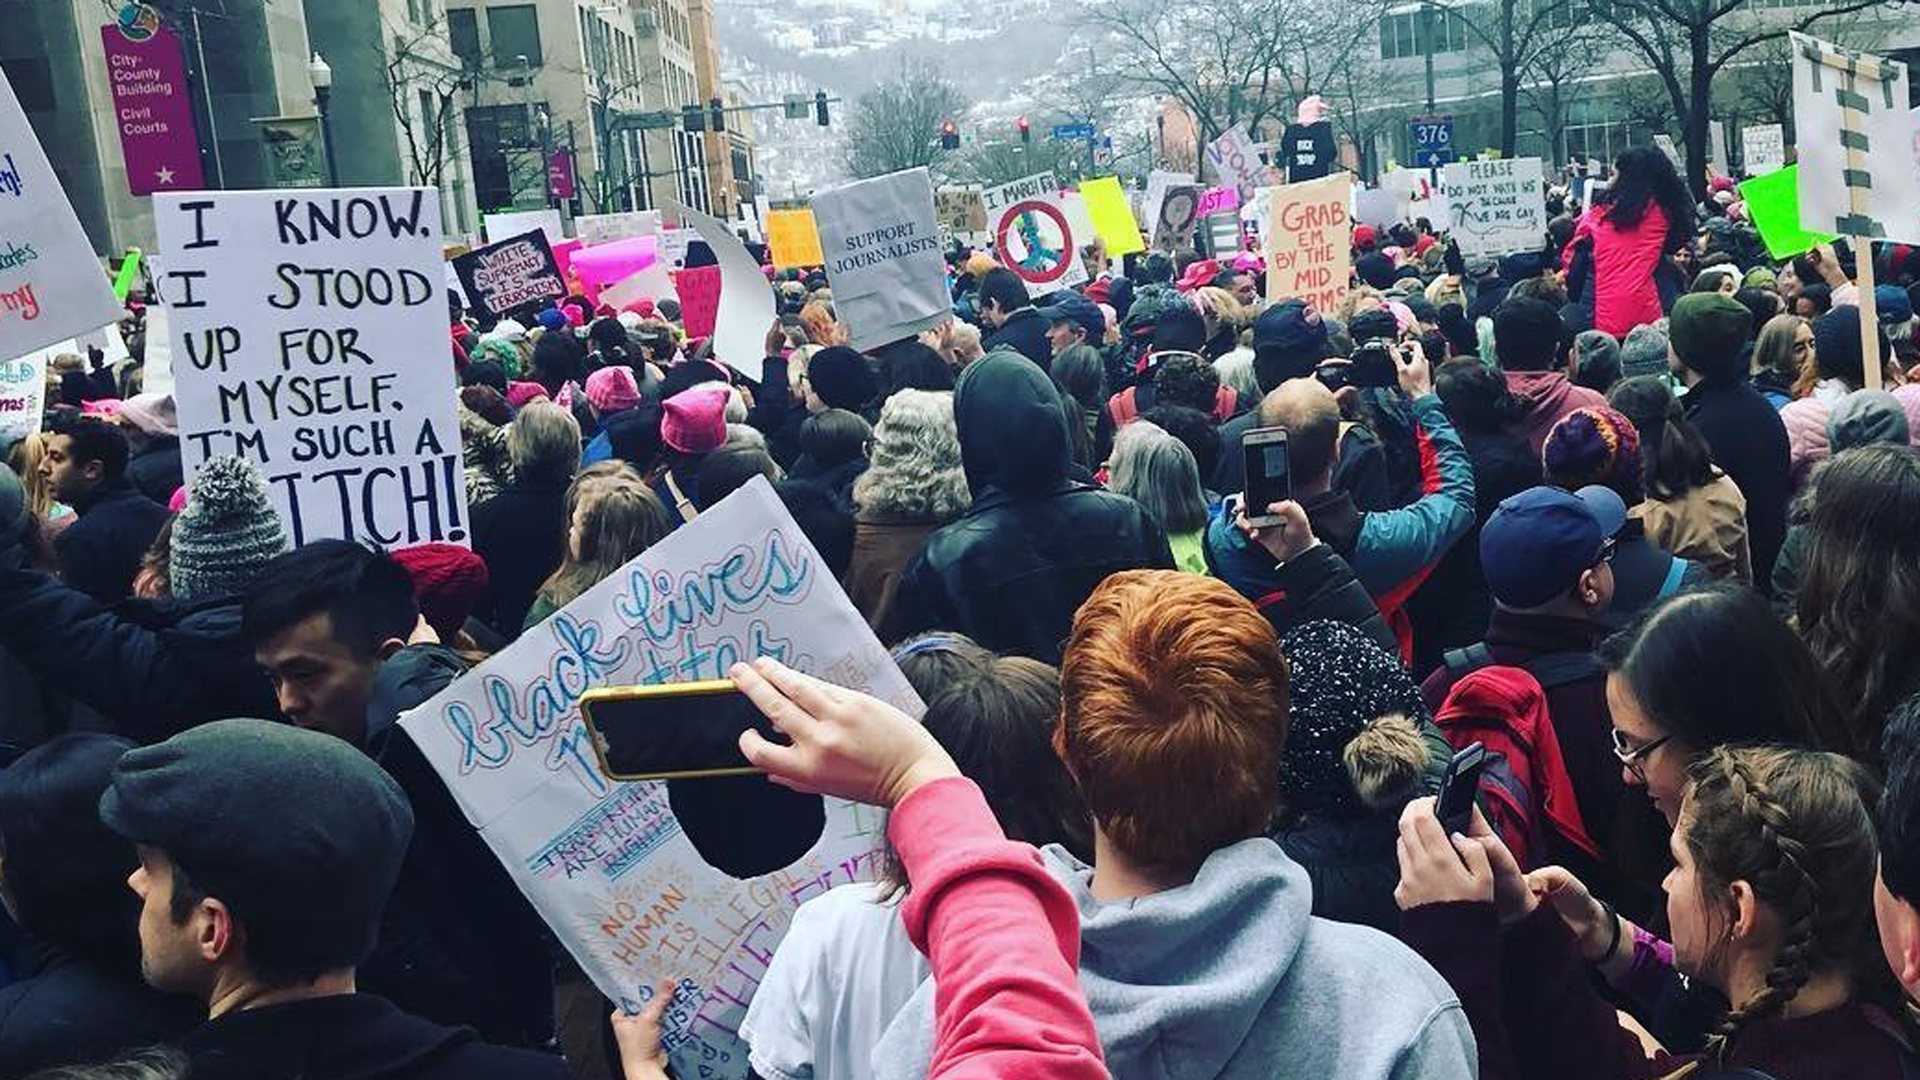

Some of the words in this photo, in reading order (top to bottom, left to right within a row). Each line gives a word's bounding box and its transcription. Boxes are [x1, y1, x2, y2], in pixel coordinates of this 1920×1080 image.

[111, 54, 142, 68] City-
[113, 68, 160, 82] County
[116, 82, 173, 97] Building
[121, 107, 151, 120] Civil
[123, 122, 169, 135] Courts
[1417, 125, 1448, 143] 376
[1470, 162, 1513, 178] PLEASE
[983, 192, 999, 210] I
[1002, 181, 1039, 204] MARCH
[1448, 186, 1463, 198] DO
[1467, 184, 1487, 195] NOT
[1522, 180, 1536, 193] US
[179, 201, 219, 250] I
[274, 190, 430, 245] KNOW.
[1282, 201, 1346, 232] GRAB
[1474, 210, 1490, 222] WE
[1516, 208, 1534, 218] GAY
[846, 222, 916, 251] SUPPORT
[1298, 229, 1324, 247] EM
[481, 243, 531, 270] WHITE
[834, 236, 937, 274] JOURNALISTS
[1275, 250, 1297, 270] BY
[1304, 244, 1335, 263] THE
[168, 270, 207, 308] I
[267, 263, 432, 310] STOOD
[476, 256, 541, 288] SUPREMACY
[498, 278, 524, 292] IS
[1294, 267, 1331, 290] MID
[488, 279, 561, 311] TERRORISM
[183, 326, 241, 372] UP
[279, 328, 374, 371] FOR
[217, 373, 404, 425] MYSELF.
[186, 428, 270, 470] I'M
[291, 419, 395, 462] SUCH
[415, 418, 444, 456] A
[269, 454, 466, 548] ITCH!
[446, 614, 628, 770] black
[620, 538, 808, 642] lives
[564, 840, 606, 879] ARE
[604, 797, 668, 845] HUMAN
[600, 813, 674, 875] RIGHTS
[601, 901, 637, 938] NO
[611, 883, 687, 966] HUMAN
[690, 869, 804, 974] ILLEGAL
[656, 921, 698, 959] IS
